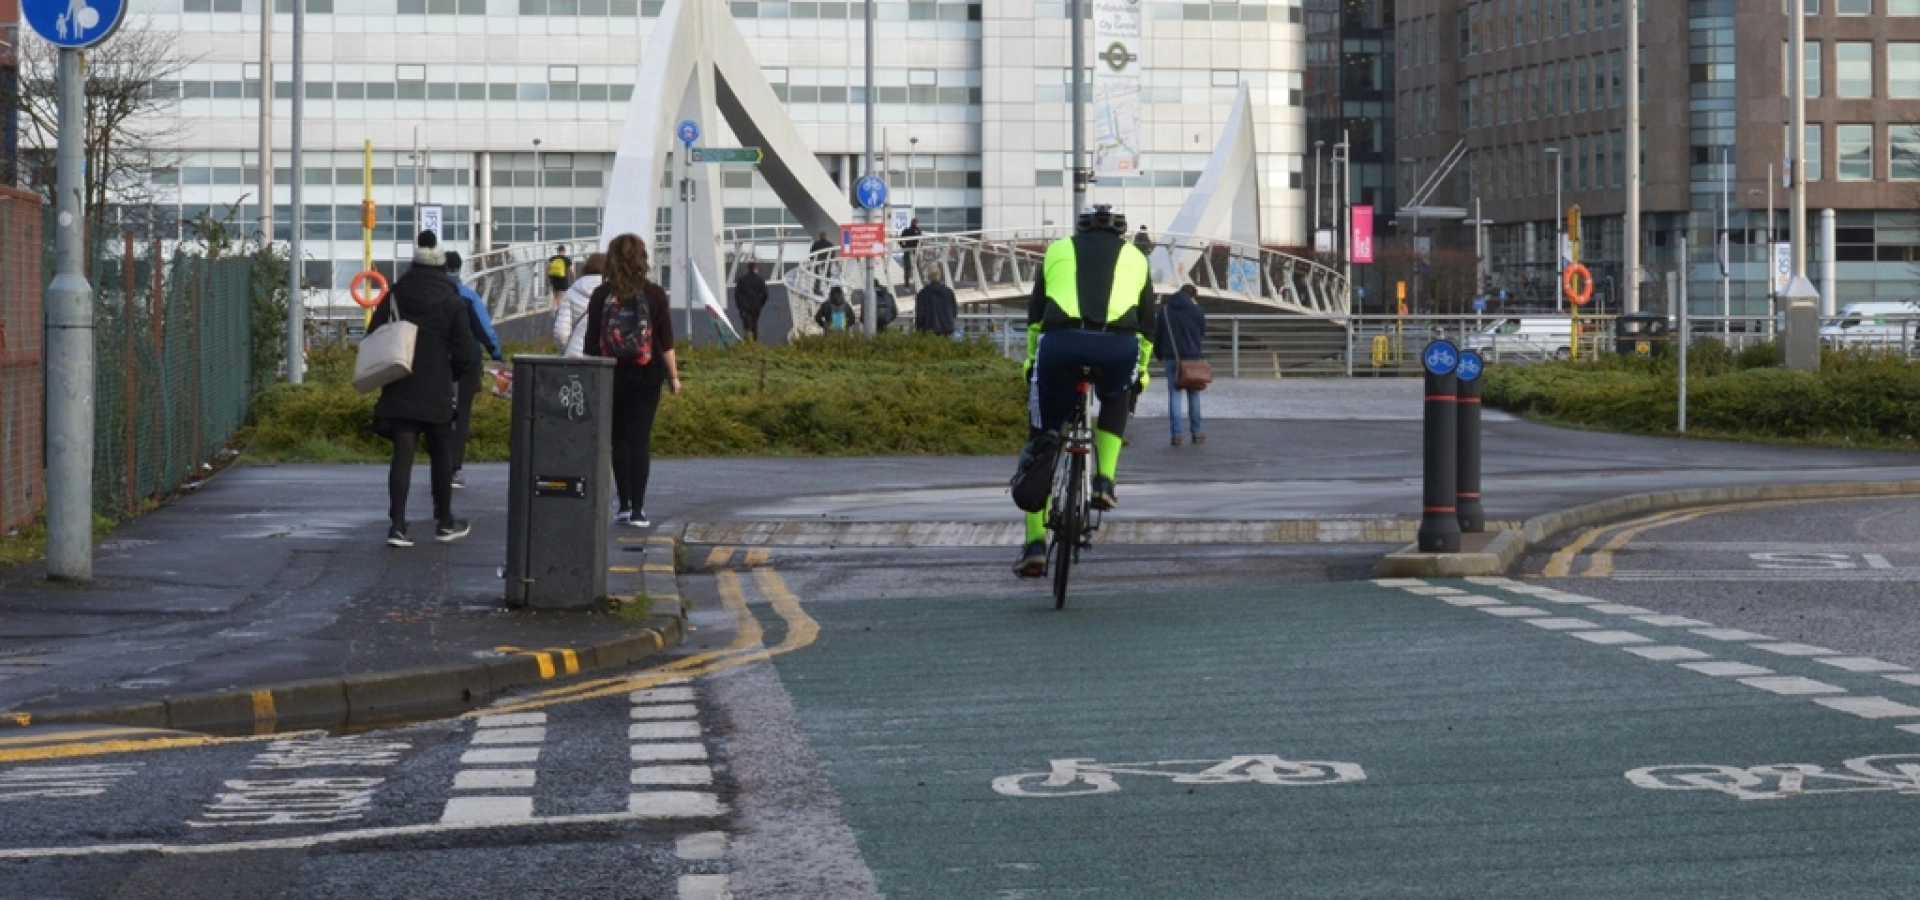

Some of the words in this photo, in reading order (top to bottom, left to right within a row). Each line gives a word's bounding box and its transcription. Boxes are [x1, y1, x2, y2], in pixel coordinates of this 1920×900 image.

[1099, 20, 1113, 30] City
[1114, 20, 1136, 29] Centre
[425, 211, 438, 228] IFS
[895, 211, 908, 230] IFS
